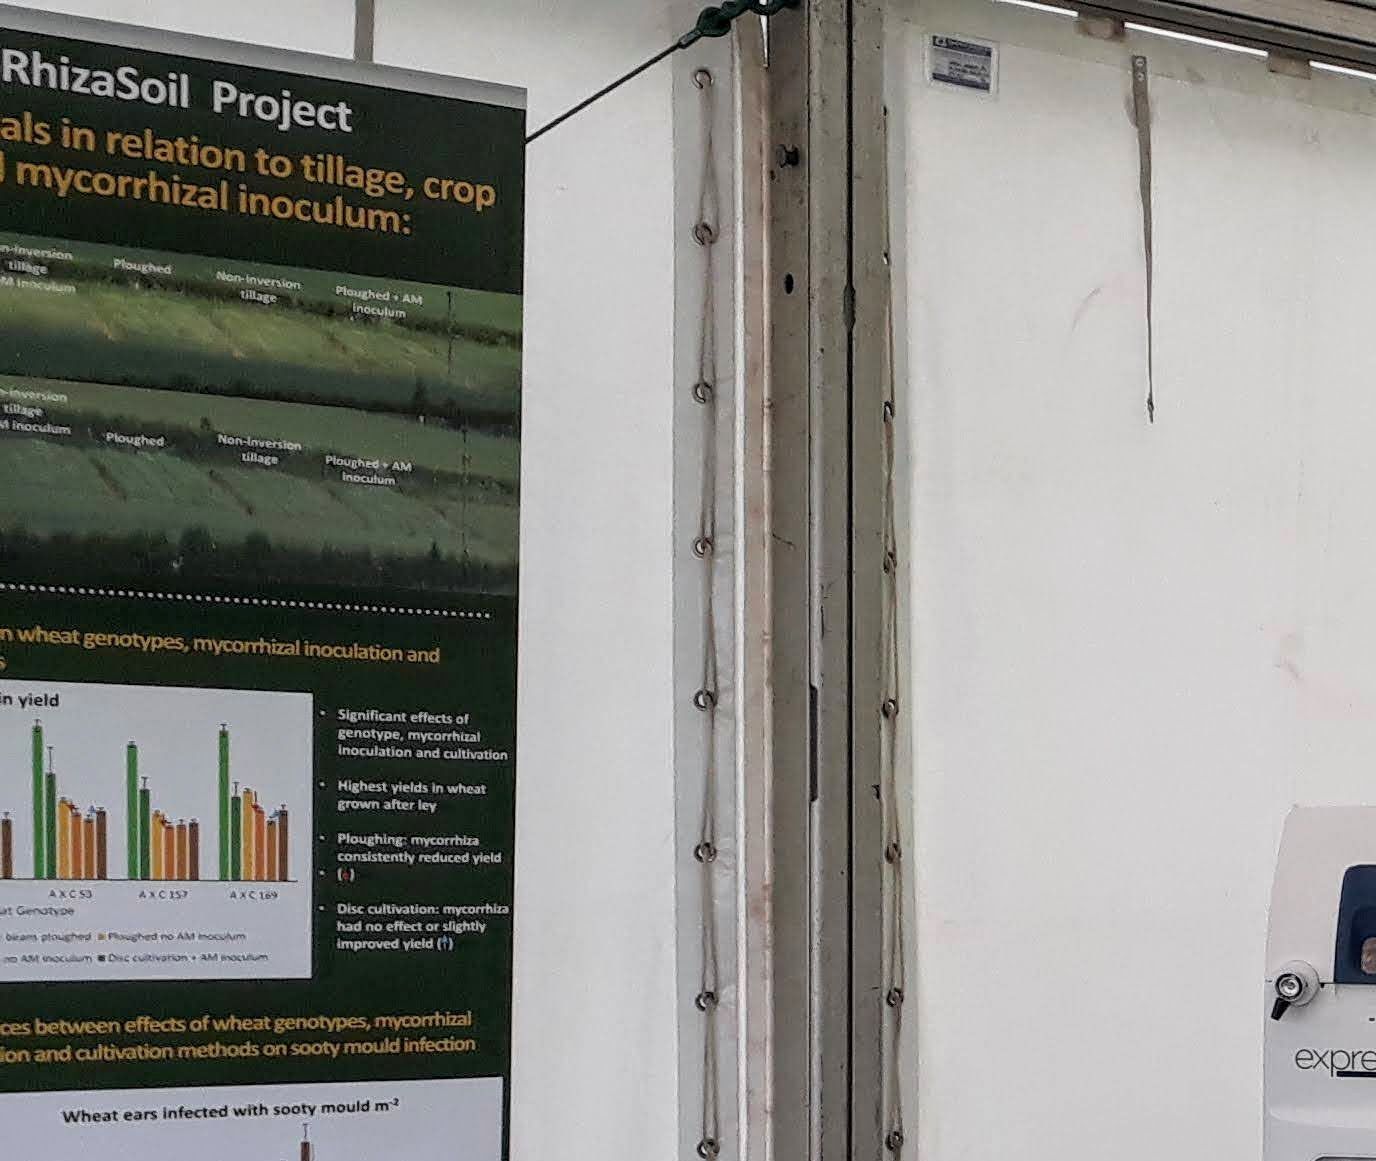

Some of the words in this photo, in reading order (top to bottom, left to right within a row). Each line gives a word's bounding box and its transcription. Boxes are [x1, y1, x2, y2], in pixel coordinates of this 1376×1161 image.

[2, 49, 189, 108] RhizaSoil
[213, 81, 353, 132] Project
[62, 118, 94, 150] in
[107, 129, 245, 171] relation
[255, 149, 292, 177] to
[301, 152, 415, 199] tillage,
[424, 176, 496, 212] crop
[16, 159, 229, 211] mycorrhizal
[239, 185, 412, 235] inoculum:
[113, 258, 172, 274] Ploughed
[241, 289, 277, 304] tillage
[336, 285, 390, 301] Ploughed
[402, 293, 423, 305] AM
[106, 432, 165, 446] Ploughed
[218, 434, 302, 451] Non-inversion
[242, 453, 278, 466] tillage
[326, 456, 379, 470] Ploughed
[392, 461, 412, 472] AM
[17, 625, 80, 646] wheat
[83, 630, 189, 652] genotypes,
[194, 634, 300, 657] mycorrhizal
[305, 641, 403, 662] inoculation
[408, 647, 440, 664] and
[18, 693, 59, 709] yield
[338, 709, 406, 724] Significant
[411, 711, 453, 724] effects
[456, 713, 469, 724] of
[338, 729, 404, 742] genotype,
[408, 731, 481, 744] mycorrhizal
[416, 747, 440, 758] and
[443, 749, 508, 760] cultivation
[338, 781, 388, 794] Highest
[391, 781, 428, 794] yields
[432, 783, 443, 793] in
[447, 784, 486, 794] wheat
[338, 800, 380, 811] grown
[384, 799, 415, 811] after
[418, 799, 437, 813] ley
[338, 833, 407, 847] Ploughing:
[411, 836, 480, 847] mycorrhiza
[337, 852, 415, 864] consistently
[419, 852, 469, 863] reduced
[473, 852, 501, 864] yield
[337, 904, 363, 914] Disc
[367, 903, 440, 914] cultivation:
[443, 904, 509, 916] mycorrhiza
[337, 921, 361, 932] had
[366, 923, 382, 932] no
[386, 921, 422, 932] effect
[426, 923, 439, 932] or
[443, 921, 486, 933] slightly
[337, 939, 399, 951] improved
[403, 939, 433, 951] yield
[35, 1014, 122, 1036] between
[125, 1013, 186, 1034] effects
[190, 1013, 210, 1032] of
[212, 1013, 272, 1032] wheat
[274, 1014, 371, 1035] genotypes,
[375, 1010, 472, 1034] mycorrhizal
[35, 1044, 72, 1062] and
[75, 1042, 174, 1061] cultivation
[178, 1039, 260, 1058] methods
[262, 1043, 287, 1056] on
[290, 1039, 340, 1060] sooty
[343, 1036, 401, 1055] mould
[403, 1034, 476, 1053] infection
[62, 1108, 119, 1125] Wheat
[123, 1109, 157, 1122] ears
[162, 1104, 229, 1119] infected
[233, 1102, 268, 1118] with
[273, 1102, 316, 1119] sooty
[321, 1099, 370, 1115] mould
